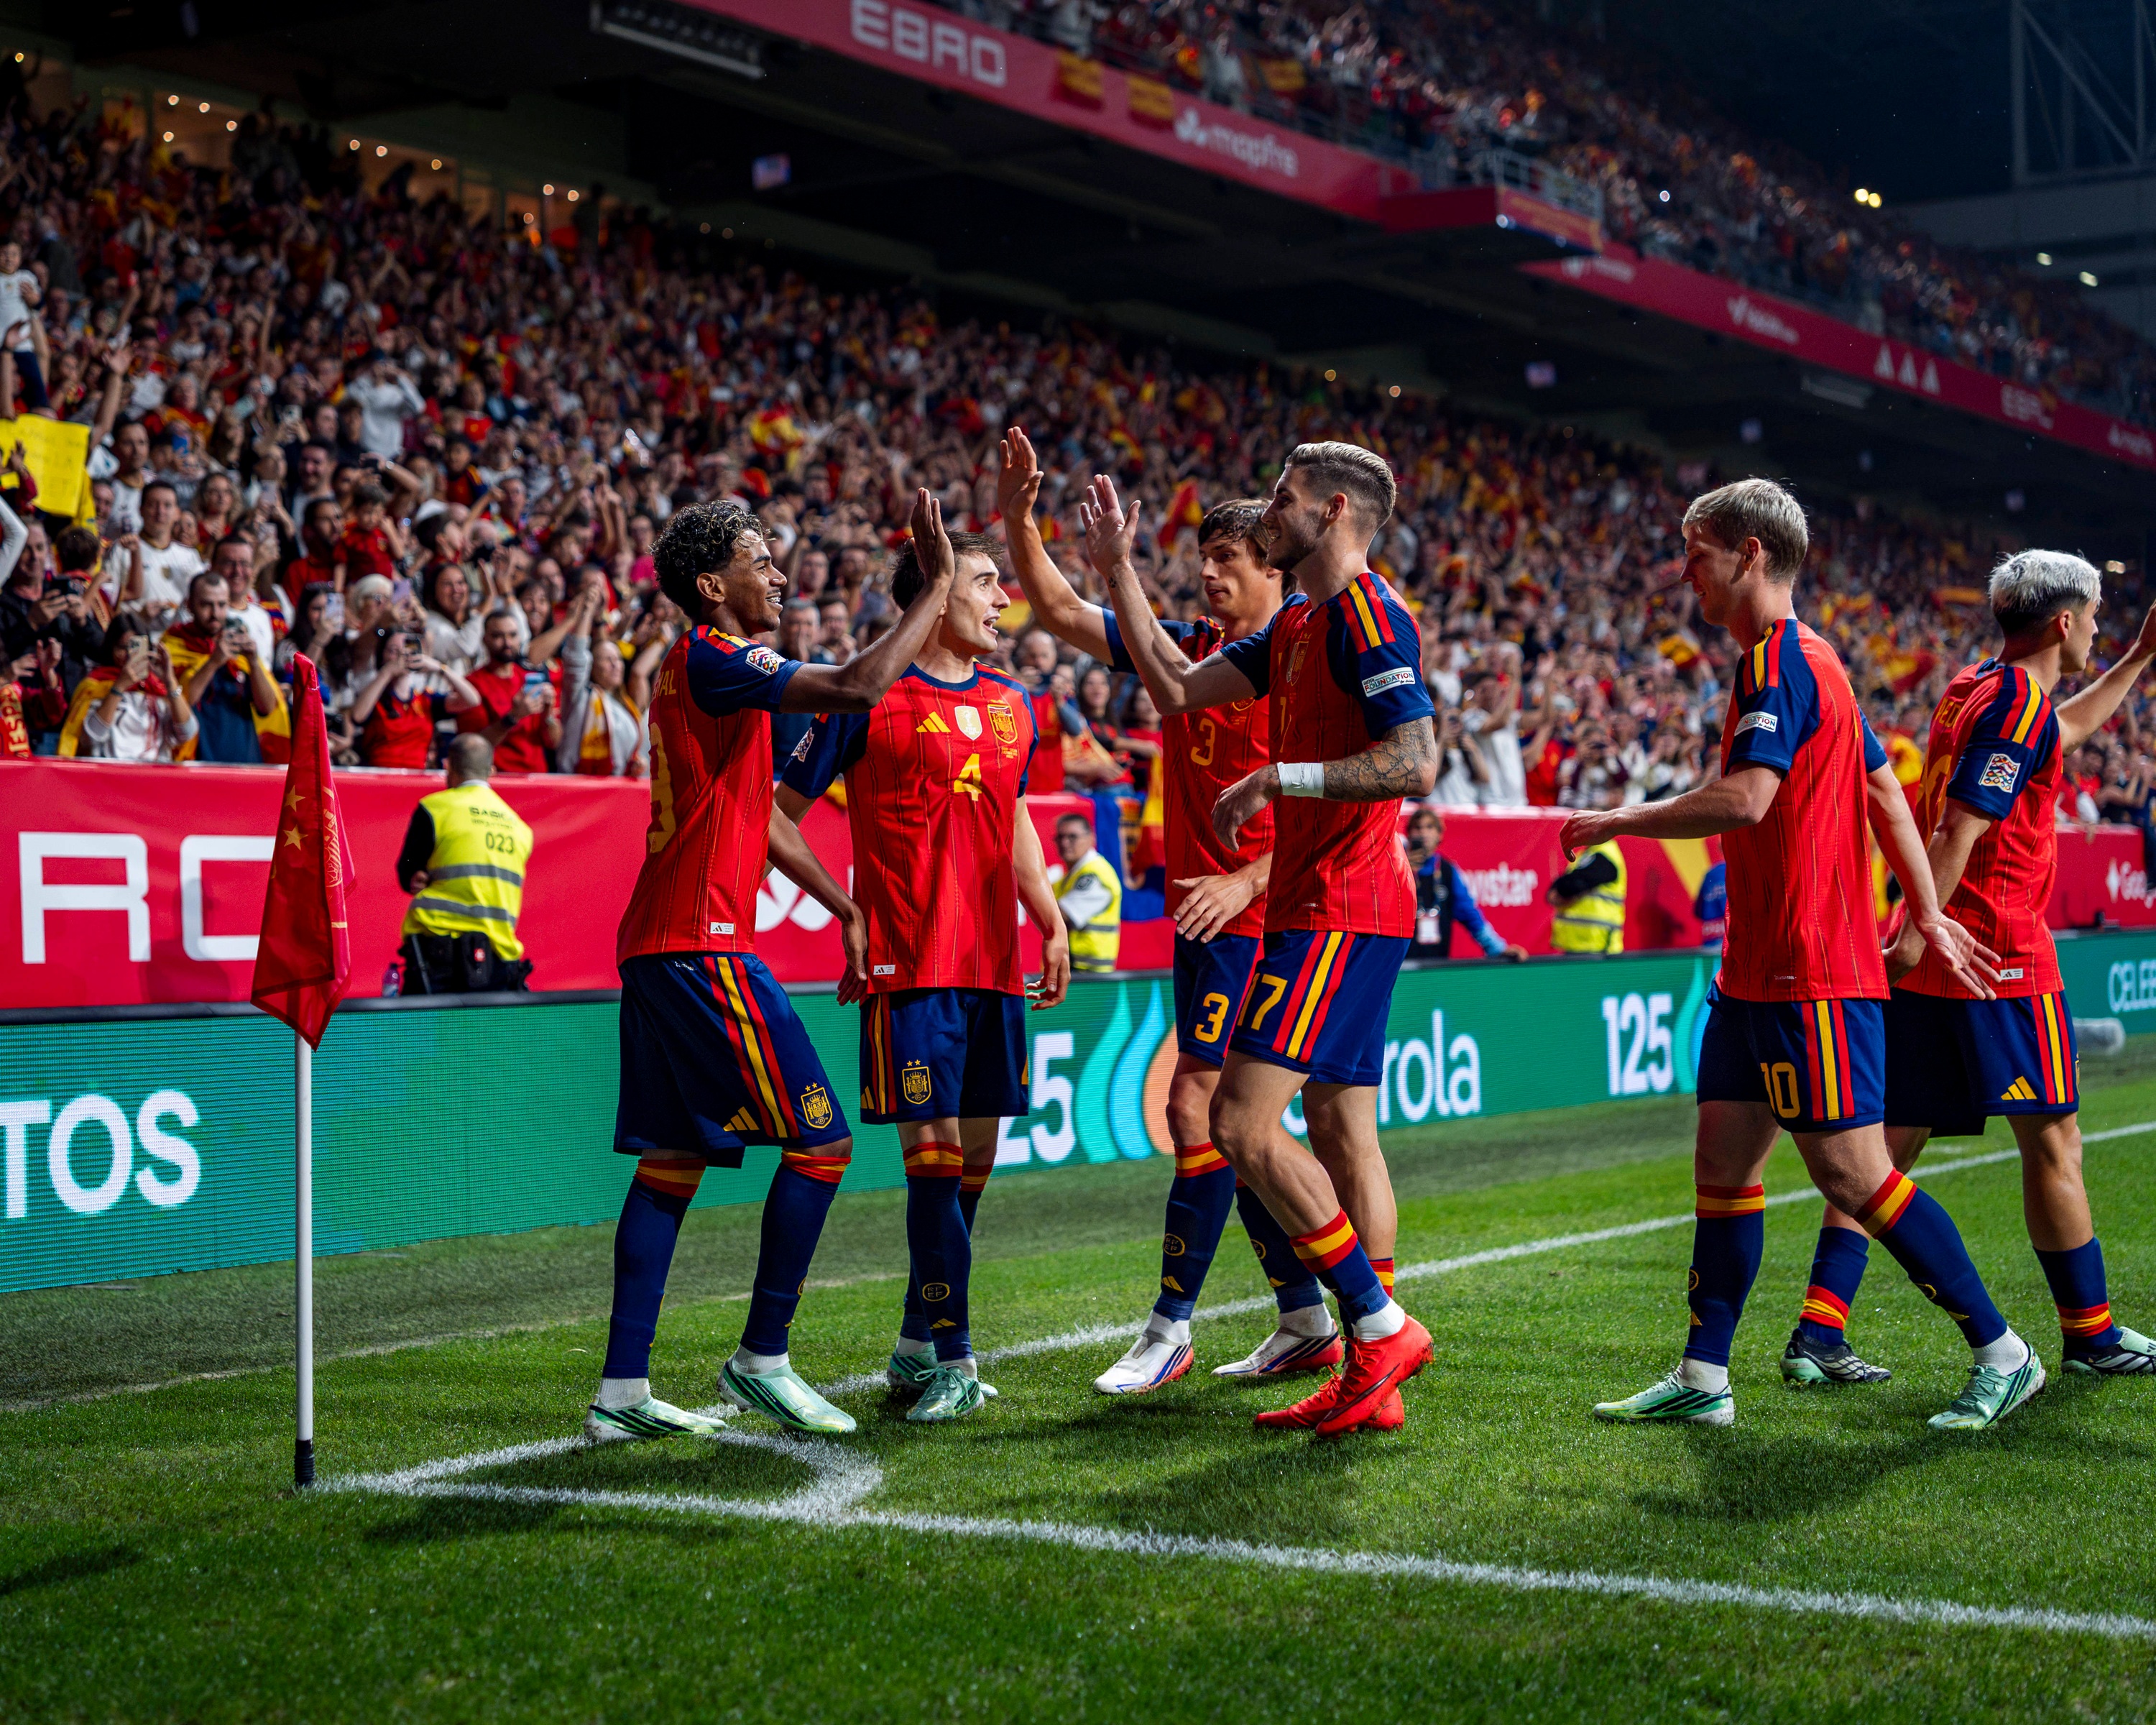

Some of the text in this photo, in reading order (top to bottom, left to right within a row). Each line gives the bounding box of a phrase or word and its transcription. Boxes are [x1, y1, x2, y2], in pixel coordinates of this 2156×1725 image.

[851, 0, 1006, 87] EBRO
[1365, 673, 1414, 691] FOUNDATION
[1191, 717, 1215, 766] 3
[954, 753, 982, 801] 4
[486, 832, 515, 854] 023
[1194, 992, 1230, 1043] 3
[1602, 992, 1674, 1096] 125
[1760, 1062, 1800, 1118] 10
[0, 1088, 201, 1220] TOS
